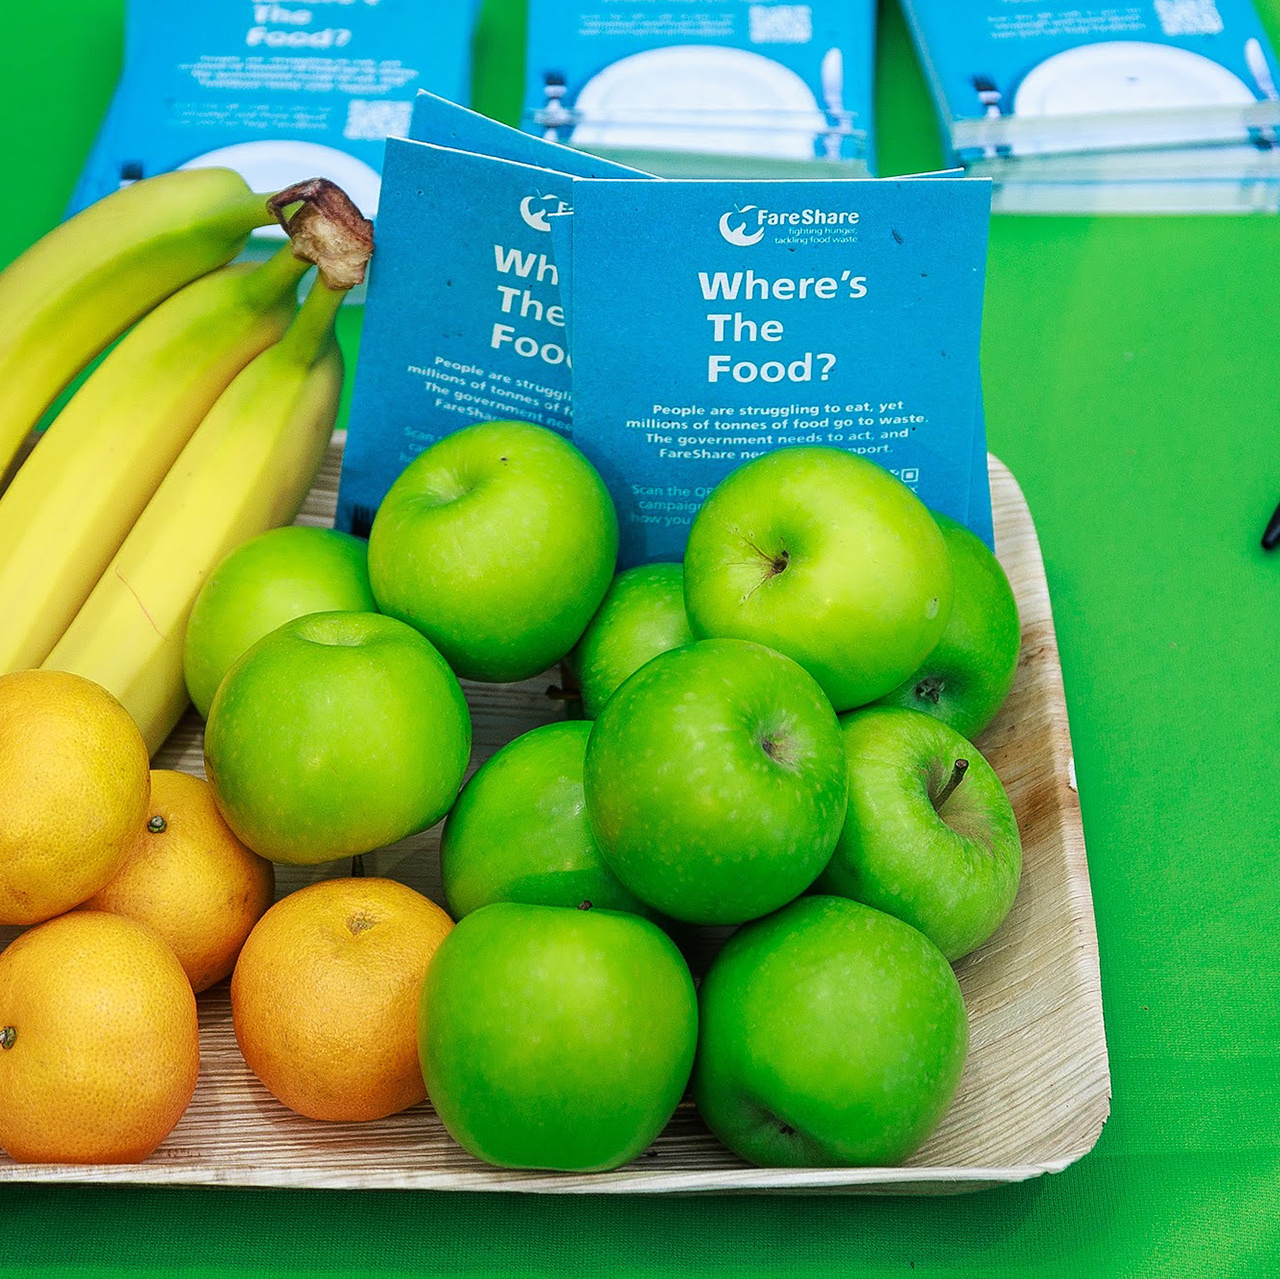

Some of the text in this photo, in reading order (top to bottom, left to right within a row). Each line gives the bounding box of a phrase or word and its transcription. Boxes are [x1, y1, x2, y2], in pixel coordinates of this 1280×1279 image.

[246, 25, 352, 49] Food?
[758, 209, 860, 226] FareShare
[775, 236, 858, 245] tackling food waste
[789, 227, 858, 237] fighting hunger,
[497, 285, 565, 327] The
[707, 312, 784, 342] The
[491, 323, 572, 369] Foo
[434, 356, 484, 376] People
[488, 372, 512, 385] are
[708, 352, 837, 383] Food?
[407, 365, 467, 386] millions
[470, 380, 487, 391] of
[491, 385, 540, 407] tonnes
[544, 401, 560, 412] of
[424, 381, 450, 395] The
[454, 391, 543, 422] government
[653, 400, 904, 418] People are struggling to eat, yet
[626, 413, 929, 431] millions of tonnes of food go to waste.
[646, 428, 910, 447] The government needs to act, and
[659, 448, 736, 460] FareShare
[631, 484, 664, 496] Scan
[667, 486, 691, 497] the
[665, 514, 691, 527] you
